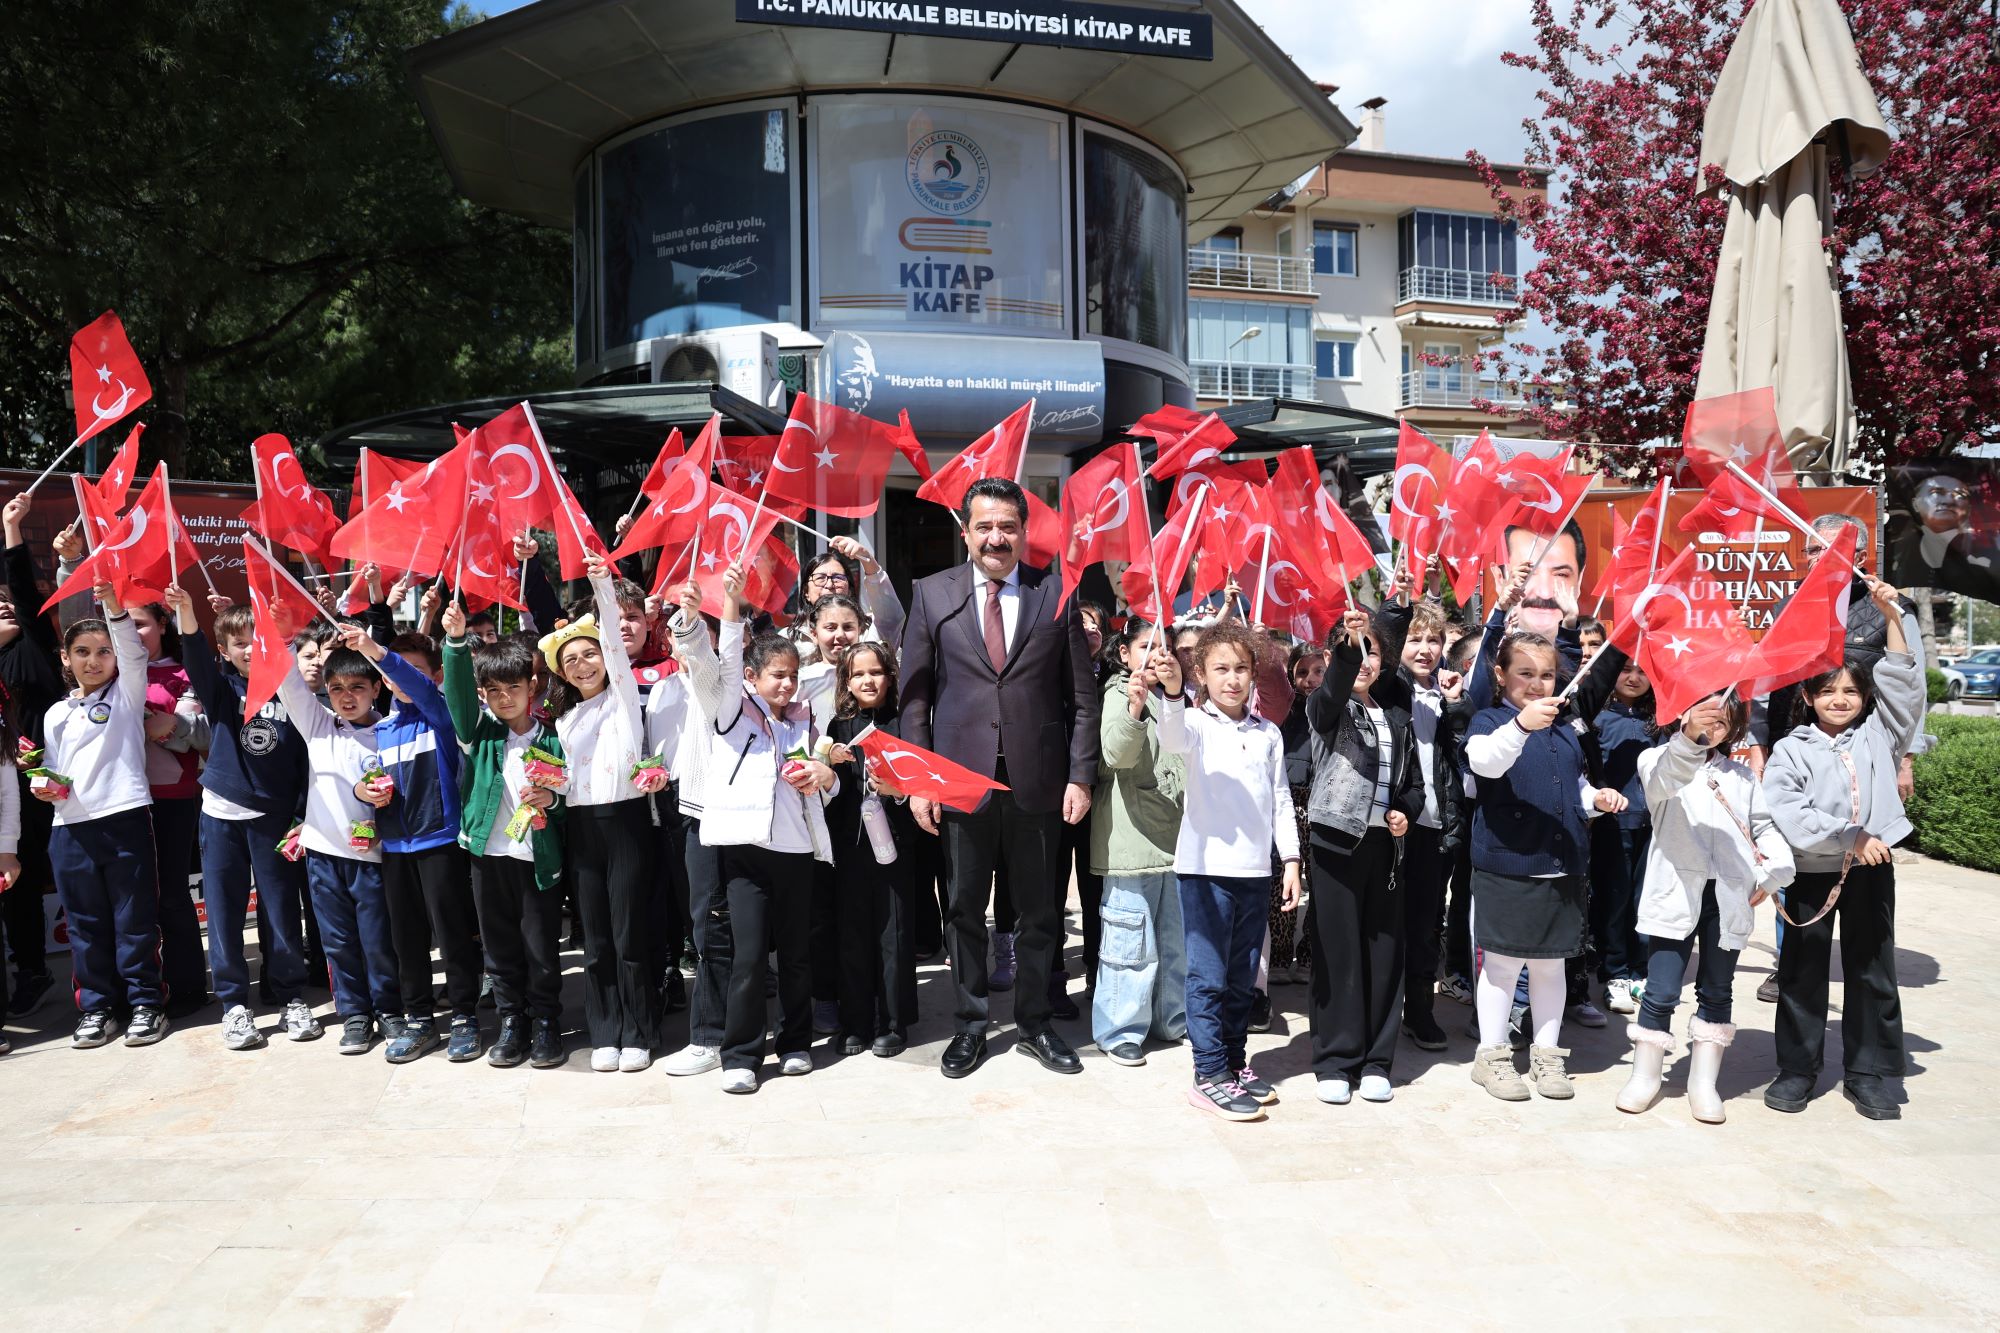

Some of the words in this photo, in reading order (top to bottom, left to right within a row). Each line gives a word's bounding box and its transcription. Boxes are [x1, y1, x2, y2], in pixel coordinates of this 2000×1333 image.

[802, 0, 939, 23] PAMUKKALE
[945, 7, 1068, 35] BELEDİYESİ
[1074, 16, 1133, 40] KİTAP
[1139, 25, 1191, 46] KAFE
[686, 227, 699, 236] en
[702, 220, 734, 234] doğru
[737, 216, 766, 231] yolu,
[676, 244, 688, 253] ve
[690, 240, 708, 251] fen
[710, 232, 759, 250] gösterir.
[899, 255, 994, 290] KİTAP
[913, 292, 980, 313] KAFE
[947, 379, 963, 388] en
[967, 377, 1007, 390] hakiki
[1011, 378, 1052, 394] mürşit
[181, 515, 222, 528] hakiki
[1696, 547, 1793, 571] DÜNYA
